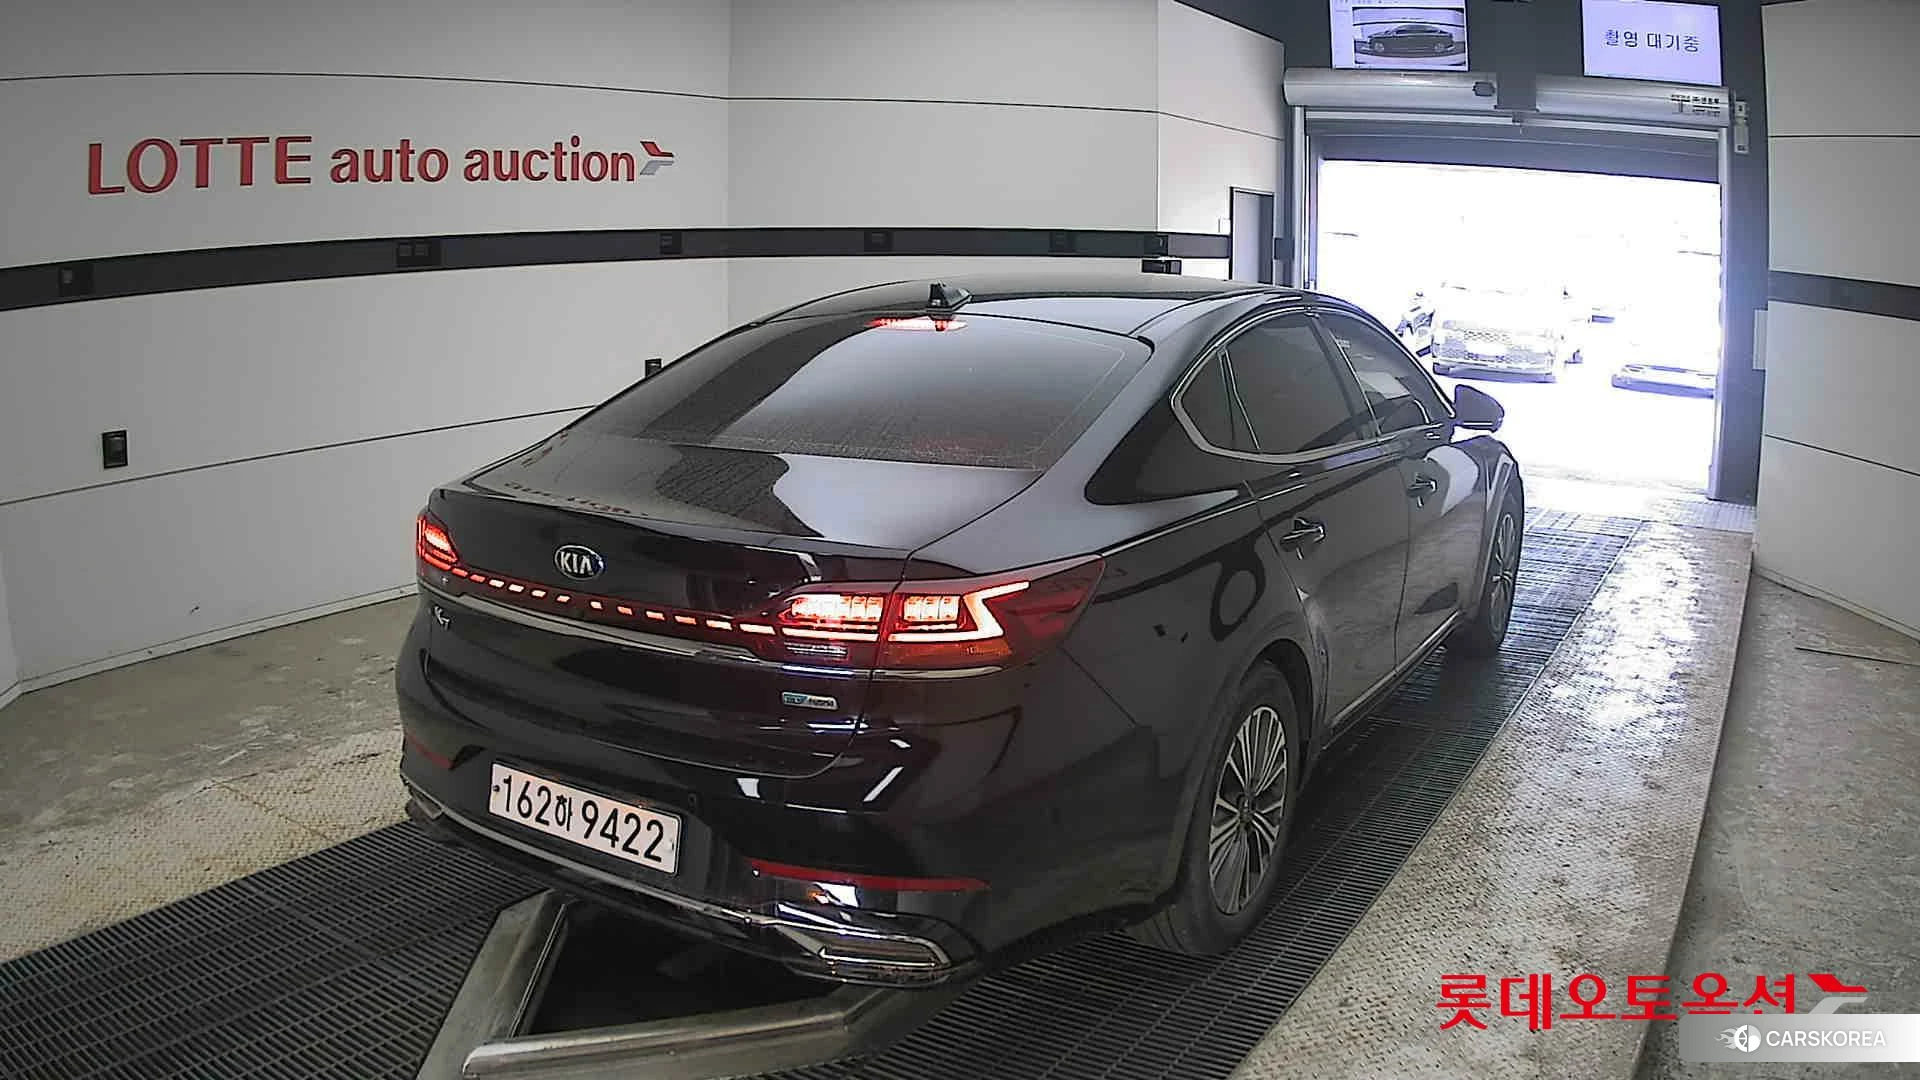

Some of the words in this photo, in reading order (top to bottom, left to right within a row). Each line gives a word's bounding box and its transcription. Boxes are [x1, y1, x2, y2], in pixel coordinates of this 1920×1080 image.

[1646, 32, 1699, 53] 대기중
[87, 136, 313, 194] LOTTE
[330, 139, 449, 184] auto
[463, 136, 636, 182] auction
[560, 551, 594, 576] KIA
[502, 775, 574, 833] 162하
[581, 800, 664, 863] 9422
